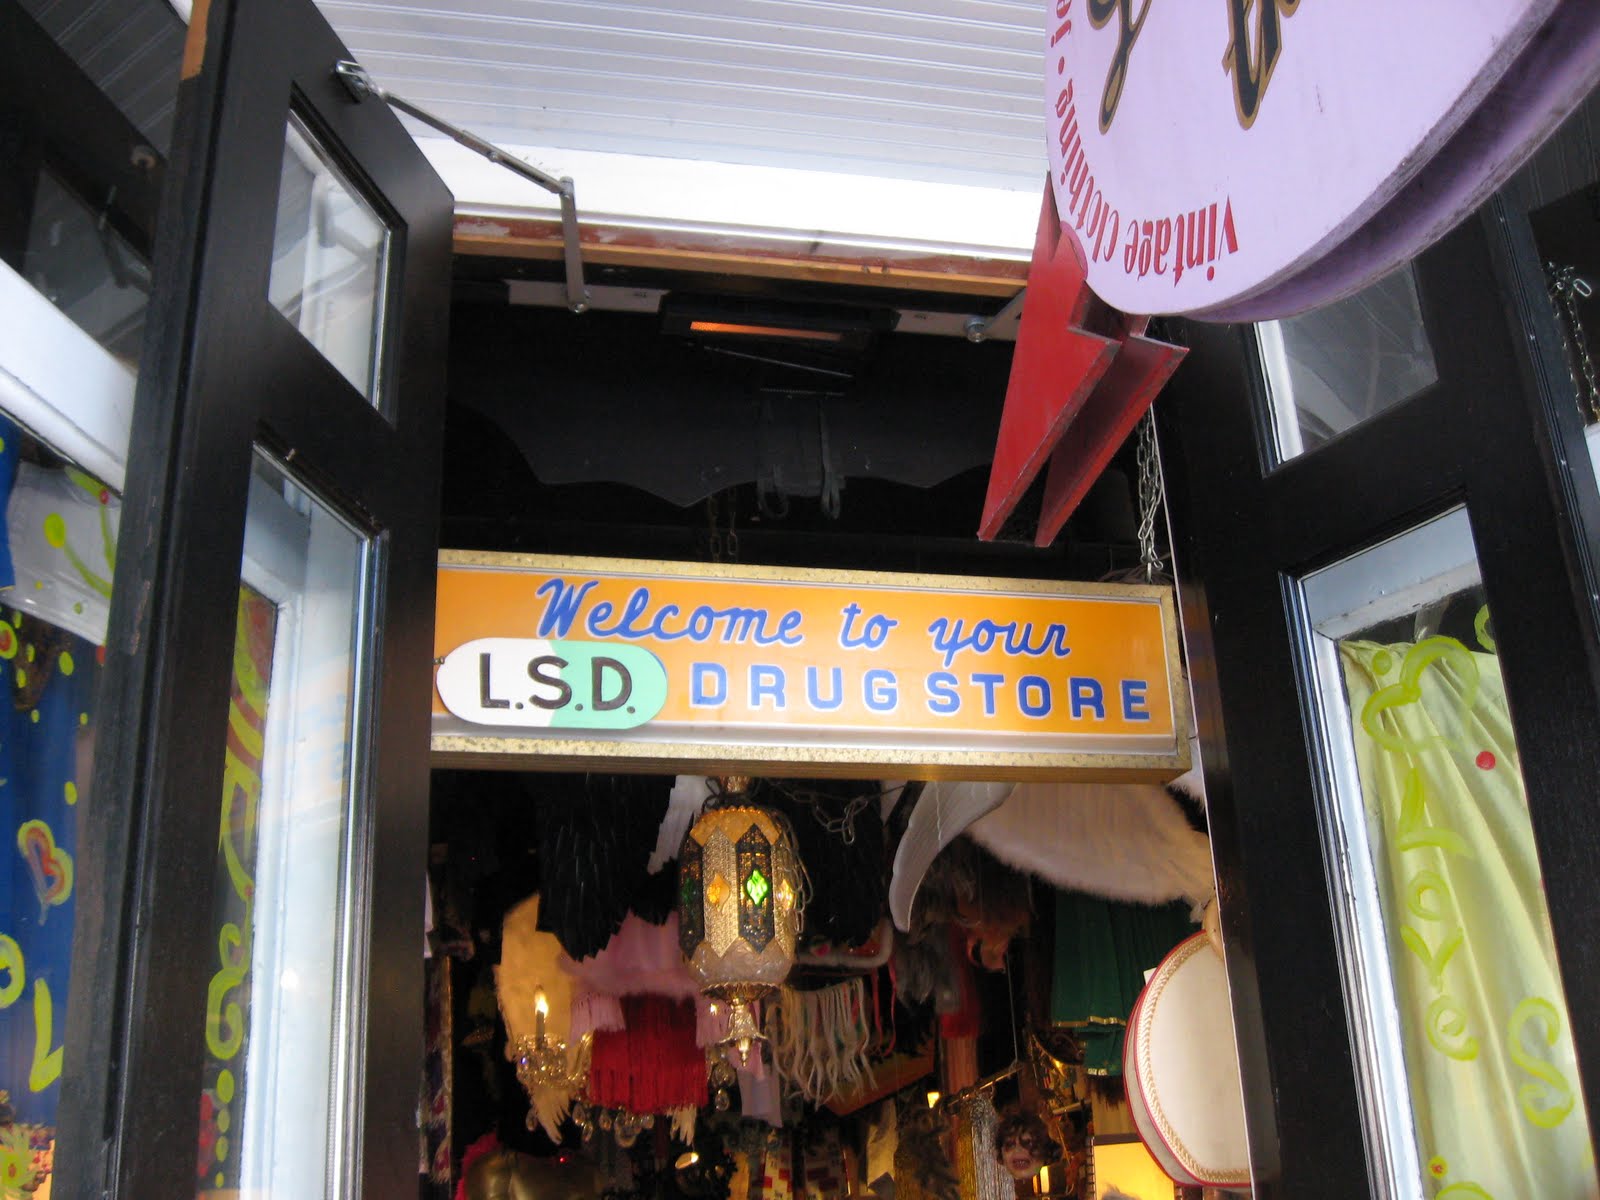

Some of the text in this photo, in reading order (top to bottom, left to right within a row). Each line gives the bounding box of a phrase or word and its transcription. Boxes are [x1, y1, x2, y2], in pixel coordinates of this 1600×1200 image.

[1055, 79, 1119, 263] clothing
[1124, 195, 1238, 287] vintage
[536, 578, 1071, 667] Welcome to your
[479, 653, 1150, 721] L.S.D. DRUG STORE
